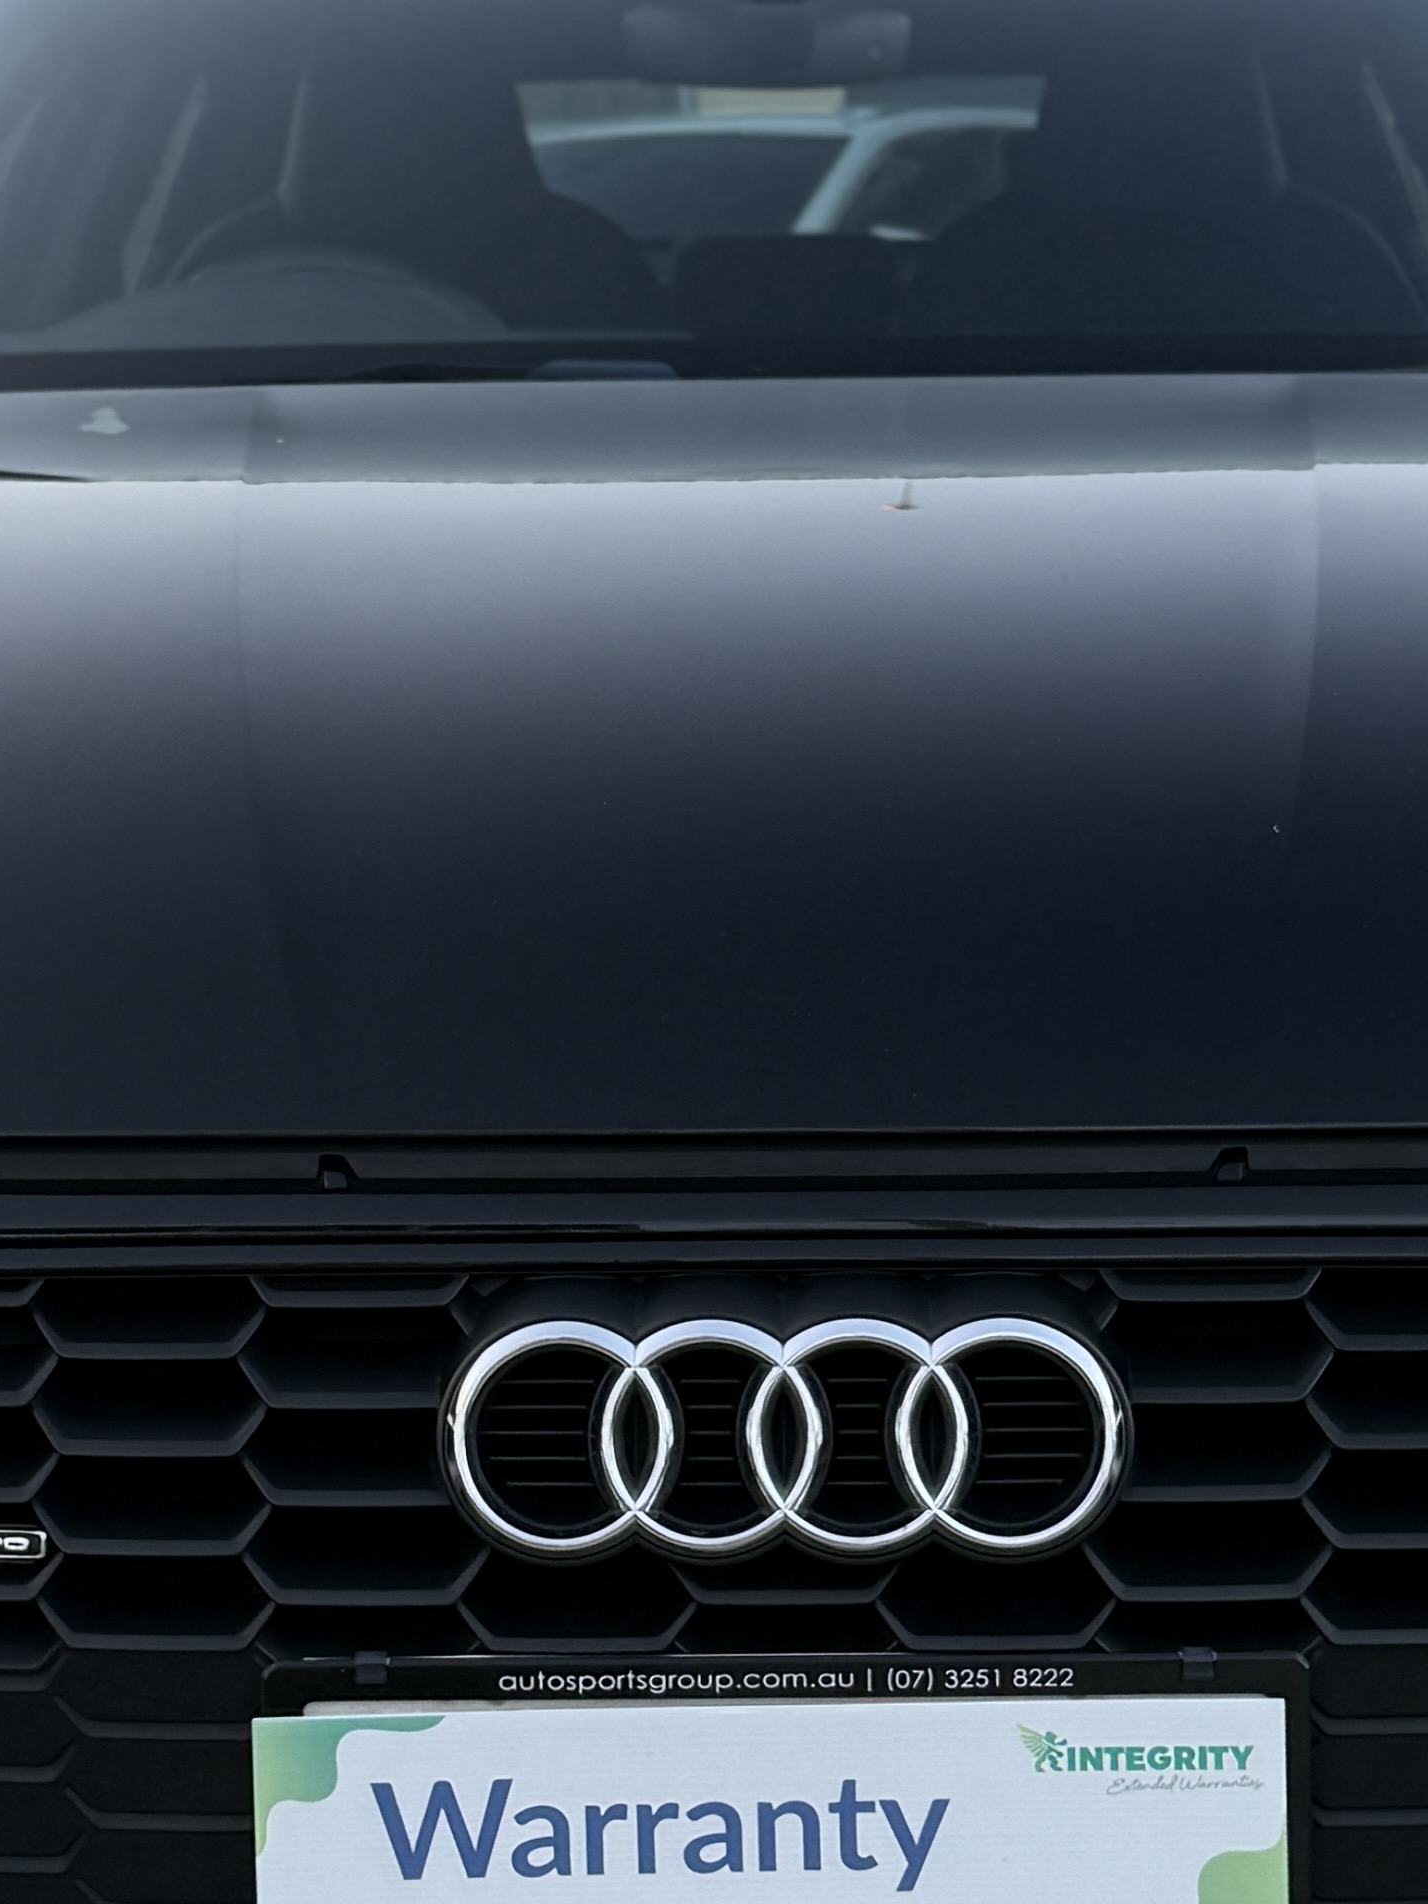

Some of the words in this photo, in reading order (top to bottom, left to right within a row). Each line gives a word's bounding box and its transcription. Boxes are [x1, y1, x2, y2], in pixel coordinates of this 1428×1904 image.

[498, 1669, 855, 1694] autosportsgroup.com.au
[886, 1667, 933, 1692] (07)
[944, 1668, 1001, 1689] 3251
[1012, 1667, 1074, 1688] 8222
[1067, 1744, 1255, 1772] INTEGRITY
[1105, 1773, 1178, 1796] Extended
[1180, 1773, 1265, 1792] Warranties
[369, 1778, 951, 1893] Warranty
